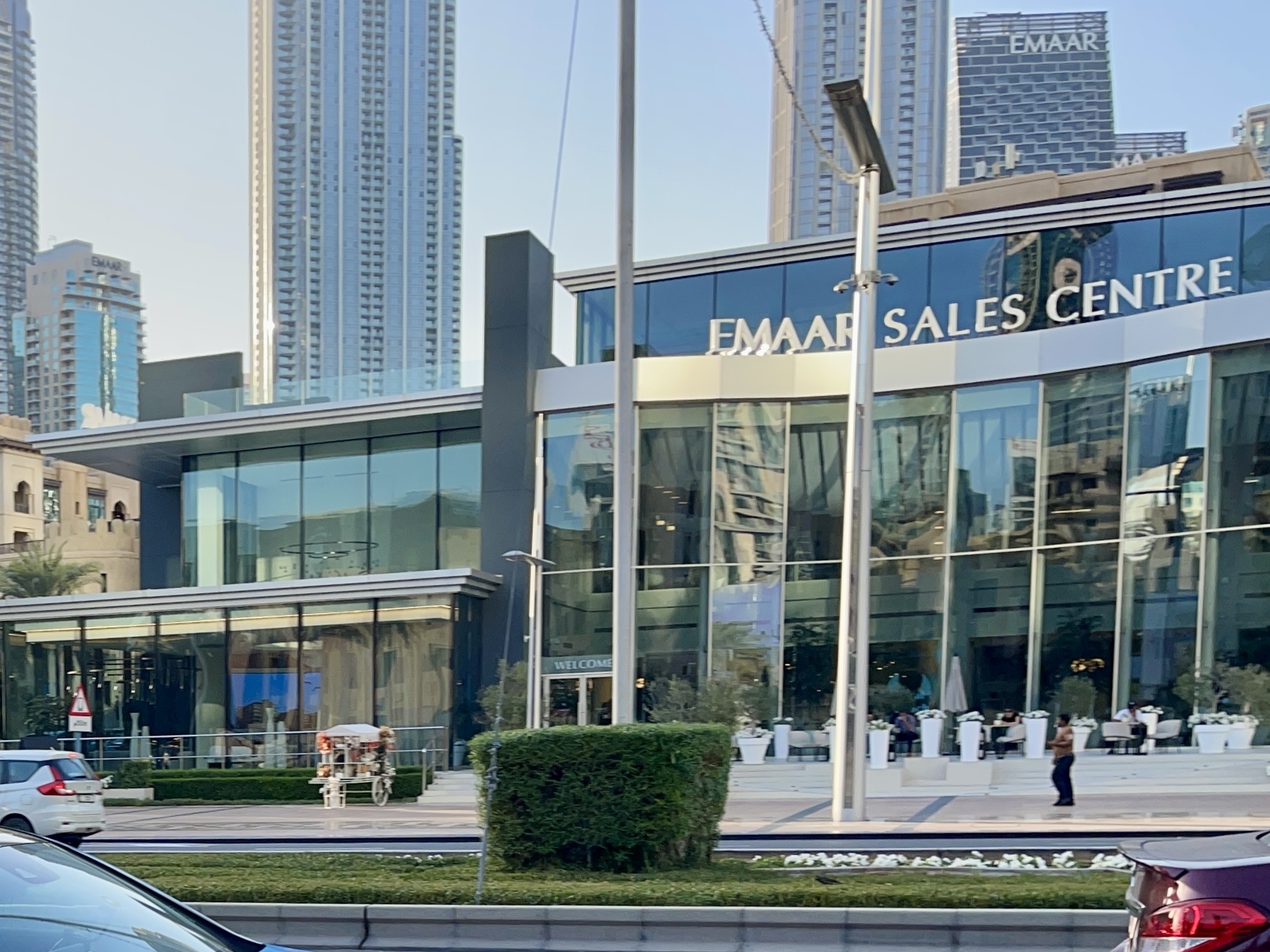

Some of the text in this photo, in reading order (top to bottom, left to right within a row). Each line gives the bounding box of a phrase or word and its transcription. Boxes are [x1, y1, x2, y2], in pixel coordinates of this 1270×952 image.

[1009, 32, 1100, 54] EMAAR
[709, 256, 1235, 354] EMAAR SALES CENTRE
[554, 658, 613, 670] WELCOME
